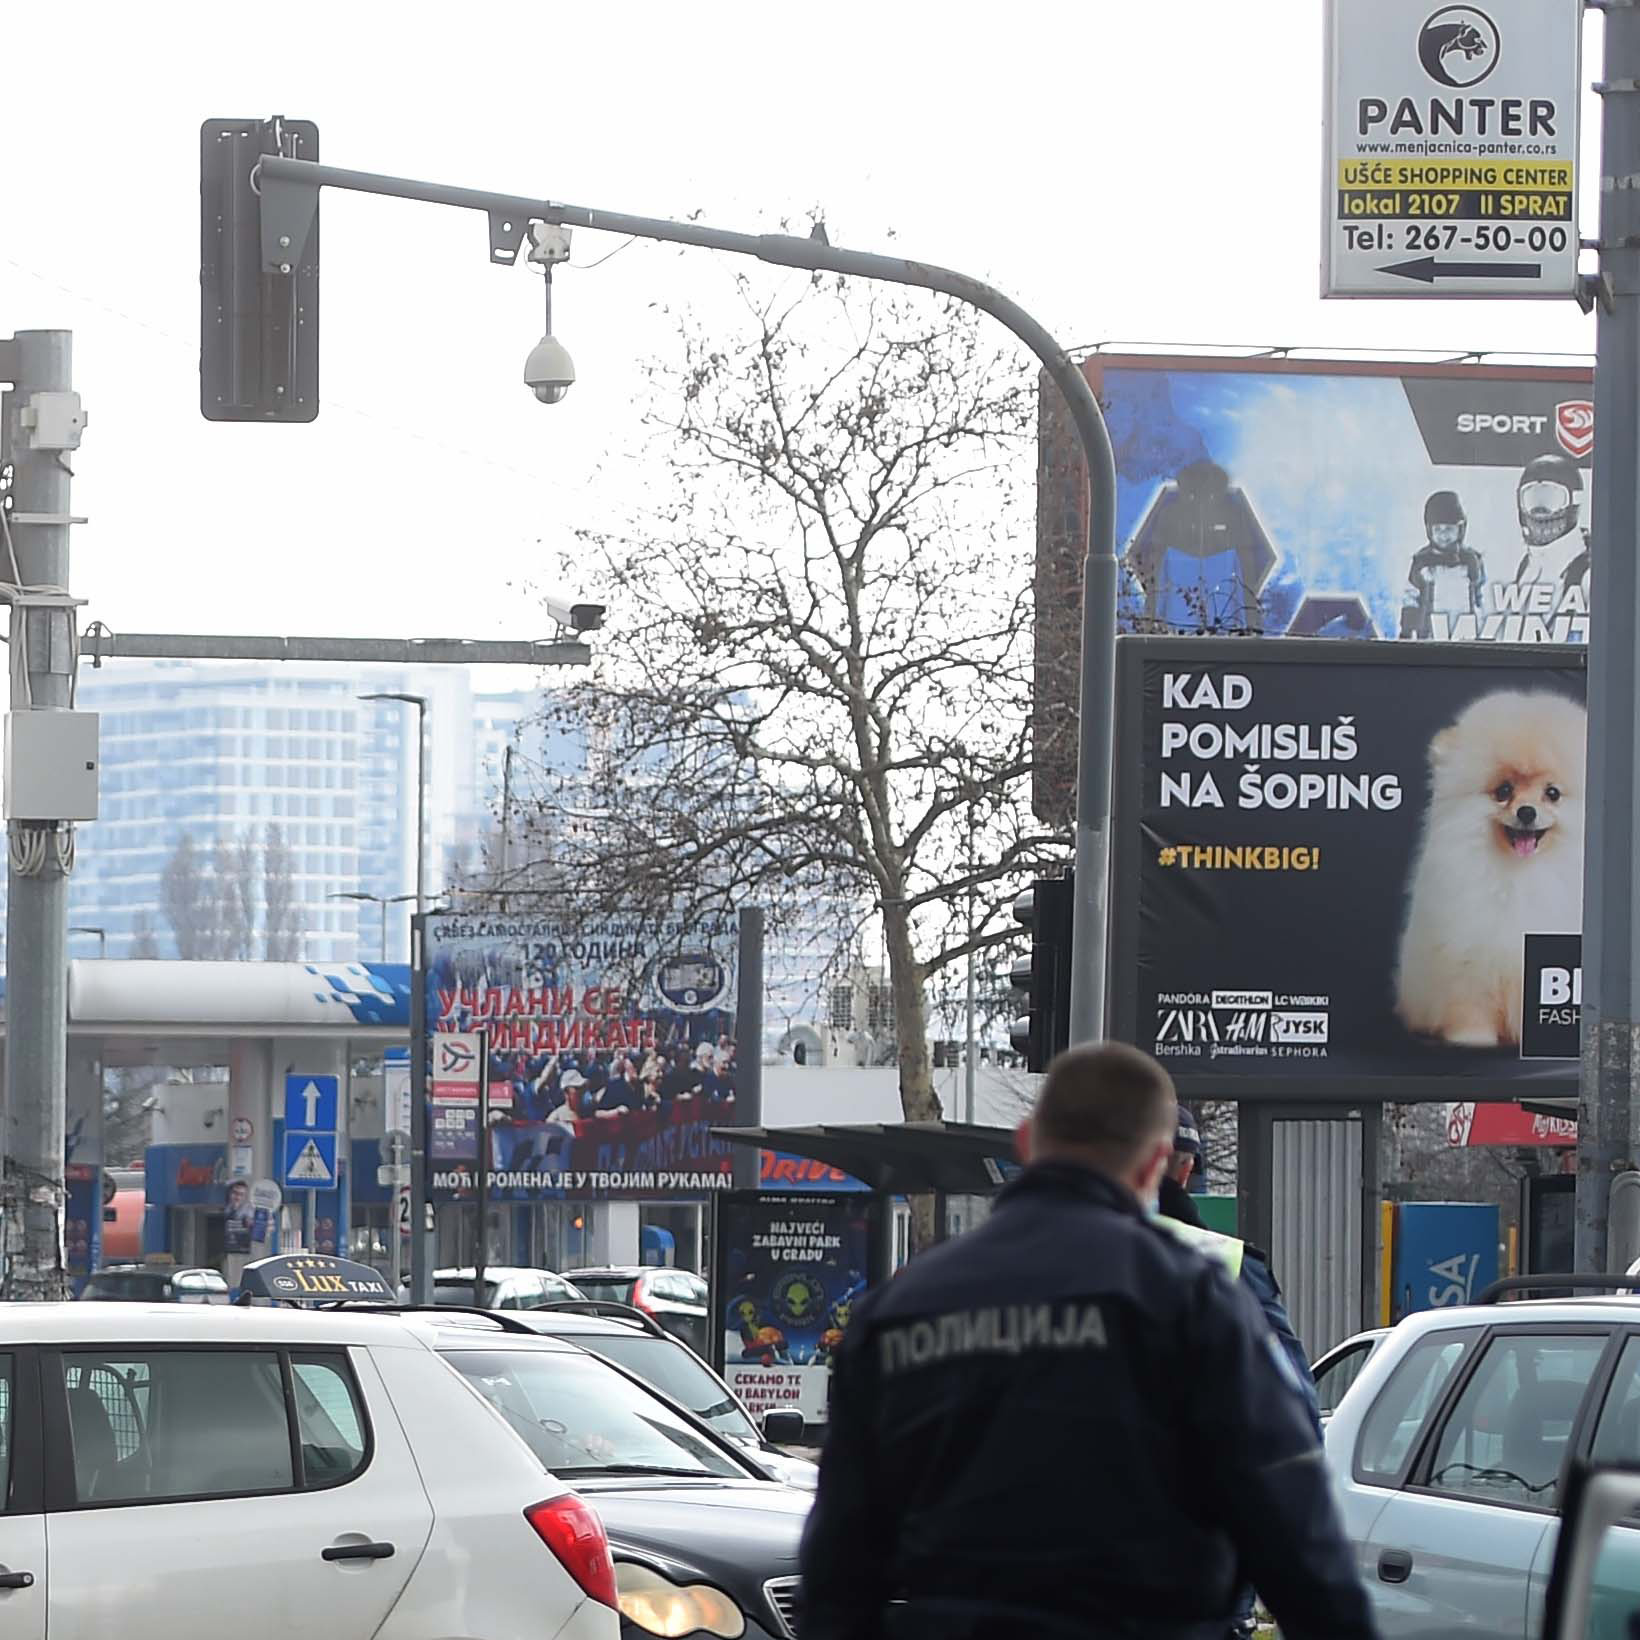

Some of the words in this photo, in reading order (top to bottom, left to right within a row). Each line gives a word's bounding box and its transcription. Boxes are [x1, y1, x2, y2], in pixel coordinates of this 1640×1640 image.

[1358, 97, 1557, 136] PANTER
[1356, 141, 1557, 156] www.menjacnica-panter.co.rs
[1344, 162, 1392, 185] UŠĆE
[1398, 167, 1497, 185] SHOPPING
[1503, 168, 1568, 185] CENTER
[1343, 193, 1401, 215] lokal
[1407, 194, 1461, 216] 2107
[1500, 195, 1568, 216] SPRAT
[1343, 223, 1394, 250] Tel:
[1405, 226, 1567, 252] 267-50-00
[1456, 413, 1548, 434] SPORT
[1492, 582, 1554, 614] WE
[1161, 672, 1253, 710] KAD
[1161, 716, 1358, 762] POMISLIŠ
[1160, 771, 1224, 808] NA
[1238, 765, 1403, 811] ŠOPING
[1157, 846, 1321, 871] #THINKBIG!
[438, 985, 575, 1018] УЧЛАНИ
[582, 986, 621, 1017] СЕ
[1158, 993, 1210, 1004] PANDORA
[1215, 994, 1270, 1005] DECATHLON
[1226, 1011, 1267, 1042] H&M
[1282, 1020, 1325, 1034] JYSK
[1155, 1043, 1201, 1056] Bershka
[1271, 1046, 1328, 1057] SEPHORA
[589, 1172, 655, 1189] ТВОЈИМ
[657, 1172, 734, 1190] РУКАМА!
[770, 1219, 825, 1235] NAJVEĆI
[752, 1235, 807, 1247] ZABAVNI
[809, 1236, 841, 1248] PARK
[771, 1249, 780, 1261] U
[782, 1249, 824, 1261] GRADU
[347, 1281, 384, 1293] TAXI
[881, 1304, 1109, 1374] ПОЛИЦИЈА
[788, 1374, 802, 1385] TE
[745, 1388, 801, 1399] BABYLON
